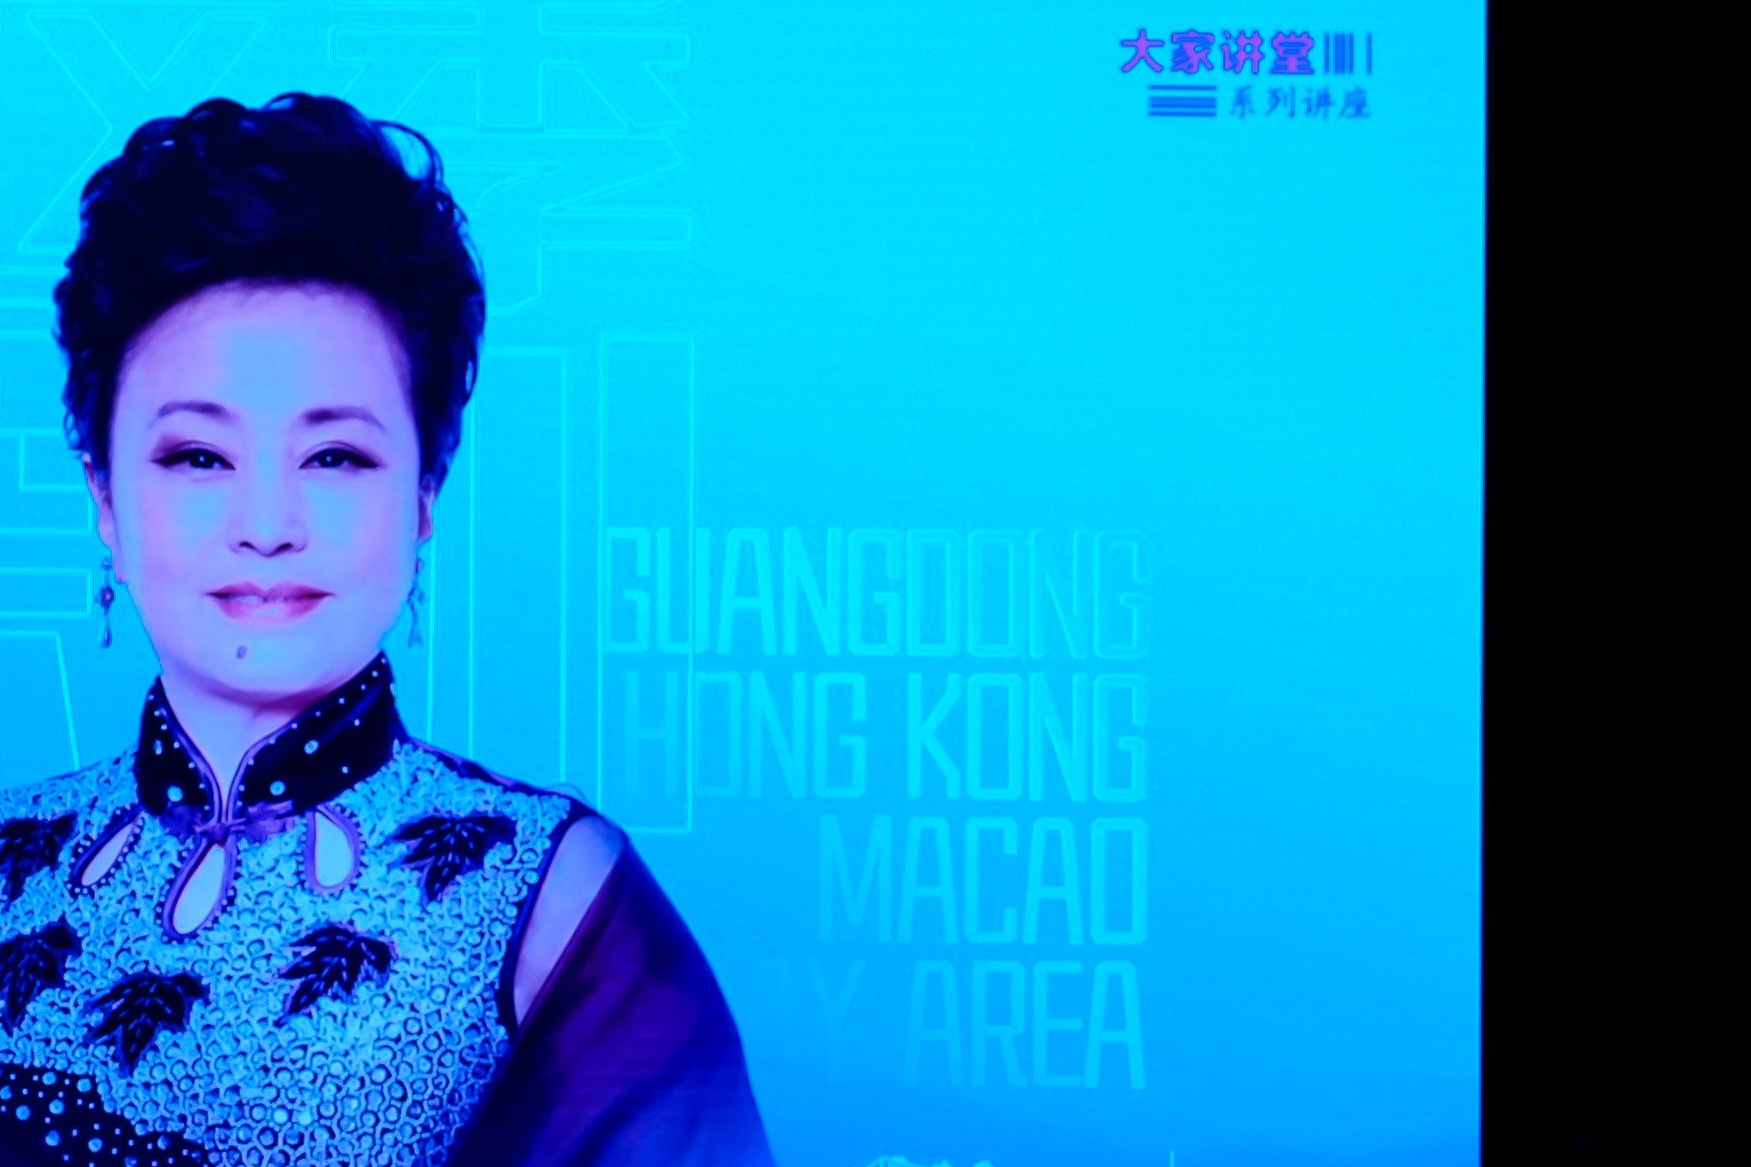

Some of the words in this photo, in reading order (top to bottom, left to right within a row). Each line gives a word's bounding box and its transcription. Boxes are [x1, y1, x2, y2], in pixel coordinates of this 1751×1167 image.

[1120, 28, 1315, 75] 大家讲堂
[1230, 85, 1371, 119] 系列讲座
[603, 526, 1150, 660] GUANGDONG
[623, 671, 867, 801] HONG
[906, 672, 1150, 803] KONG
[817, 814, 1148, 945] MACAO
[903, 960, 1146, 1090] AREA
